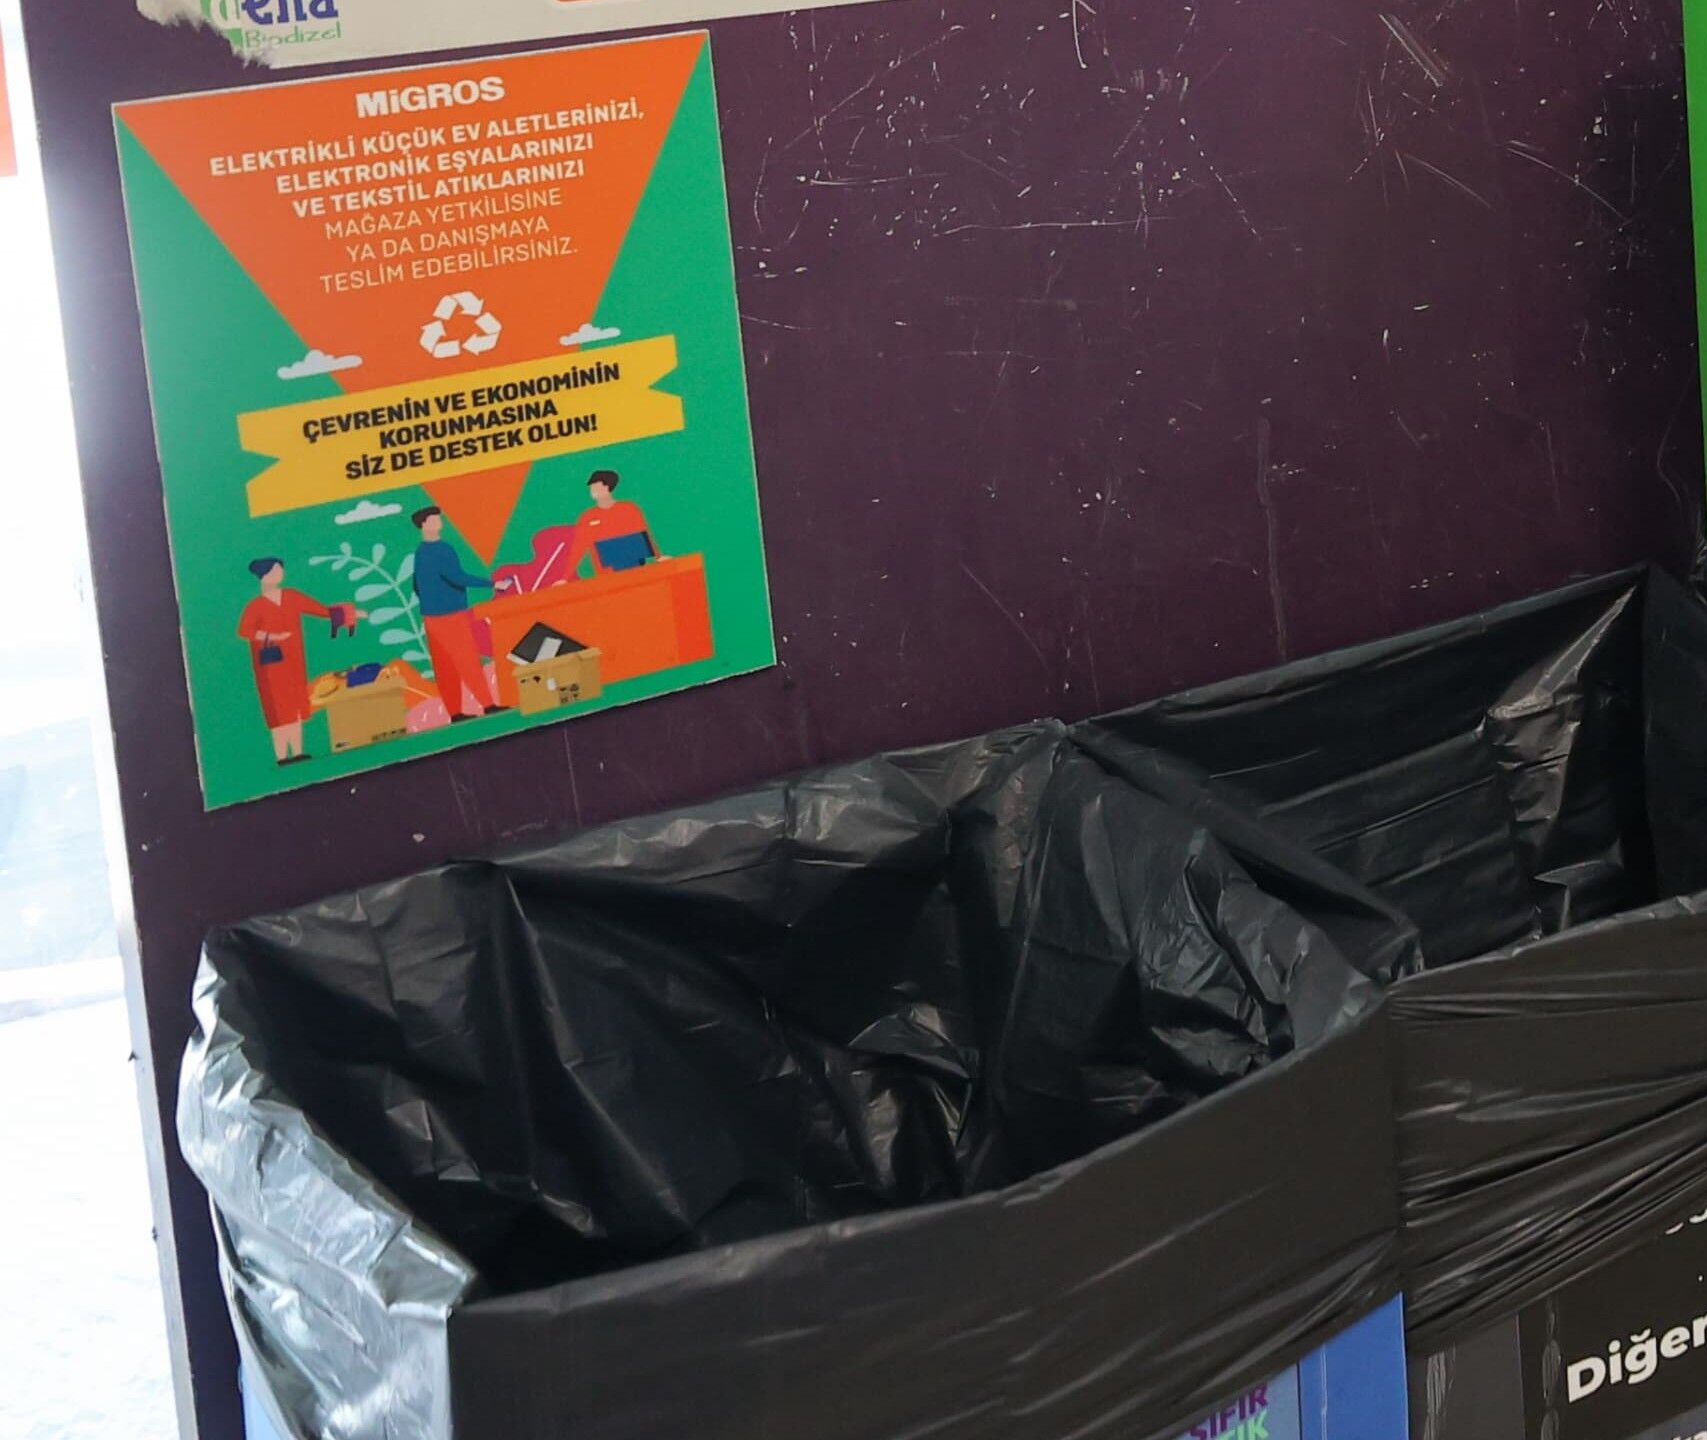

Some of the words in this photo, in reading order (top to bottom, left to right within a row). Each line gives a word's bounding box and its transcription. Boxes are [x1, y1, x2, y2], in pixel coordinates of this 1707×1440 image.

[210, 135, 356, 177] ELEKTRİKLİ
[362, 126, 446, 156] KÜÇÜK
[452, 122, 481, 144] EV
[486, 96, 645, 139] ALETLERİNİZİ,
[276, 153, 432, 194] ELEKTRONİK
[437, 132, 593, 173] EŞYALARINIZI
[292, 197, 326, 219] VE
[331, 179, 431, 214] TEKSTİL
[434, 159, 585, 199] ATIKLARINIZI
[325, 209, 423, 241] MAĞAZA
[426, 187, 563, 225] YETKİLİSİNE
[320, 263, 405, 294] TESLİM
[411, 235, 579, 280] EDEBİLİRSİNİZ.
[346, 243, 377, 263] YA
[382, 237, 415, 259] DA
[420, 215, 550, 253] DANIŞMAYA
[302, 396, 431, 444] ÇEVRENİN
[434, 392, 467, 414] VE
[472, 361, 621, 408] EKONOMİNİN
[379, 399, 558, 450] KORUNMASINA
[345, 454, 385, 480] SİZ
[391, 447, 425, 472] DE
[429, 426, 524, 464] DESTEK
[527, 413, 599, 444] OLUN!
